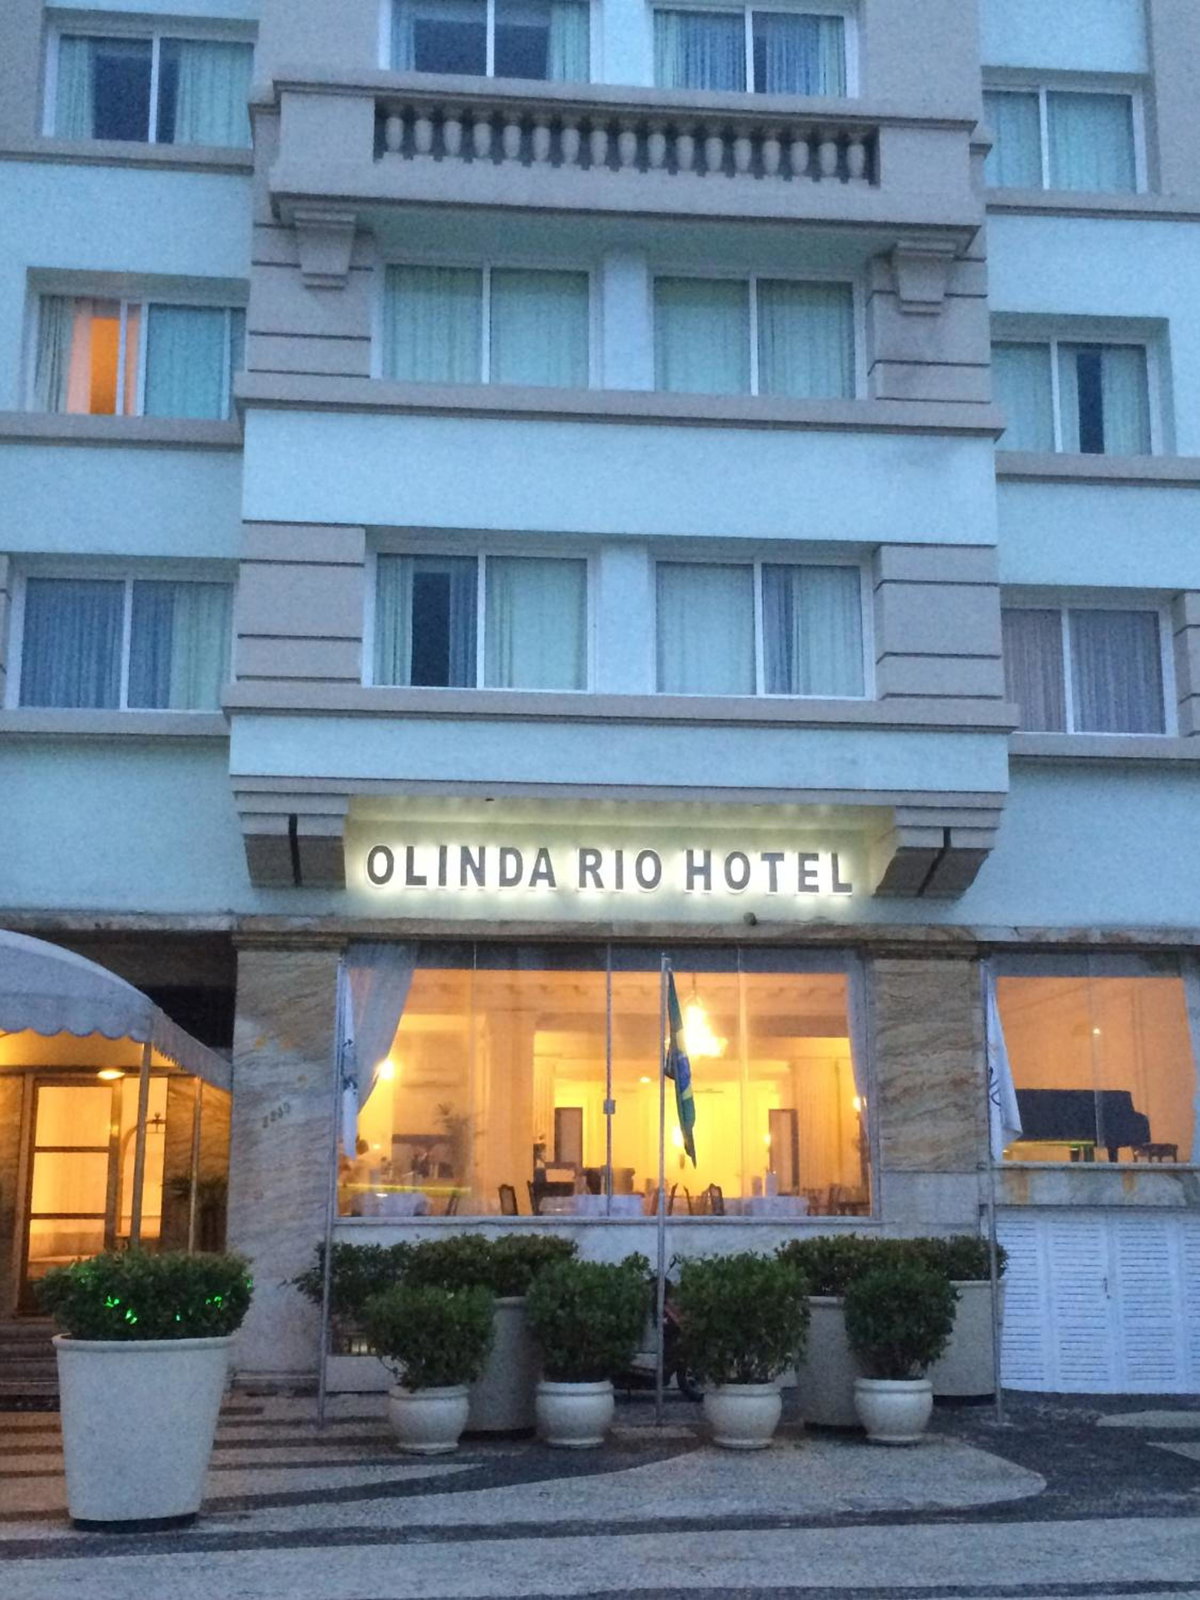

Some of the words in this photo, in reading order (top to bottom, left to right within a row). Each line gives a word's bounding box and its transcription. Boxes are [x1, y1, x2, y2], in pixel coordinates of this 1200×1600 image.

[366, 844, 558, 889] OLINDA
[577, 847, 663, 891] RIO
[685, 849, 854, 894] HOTEL
